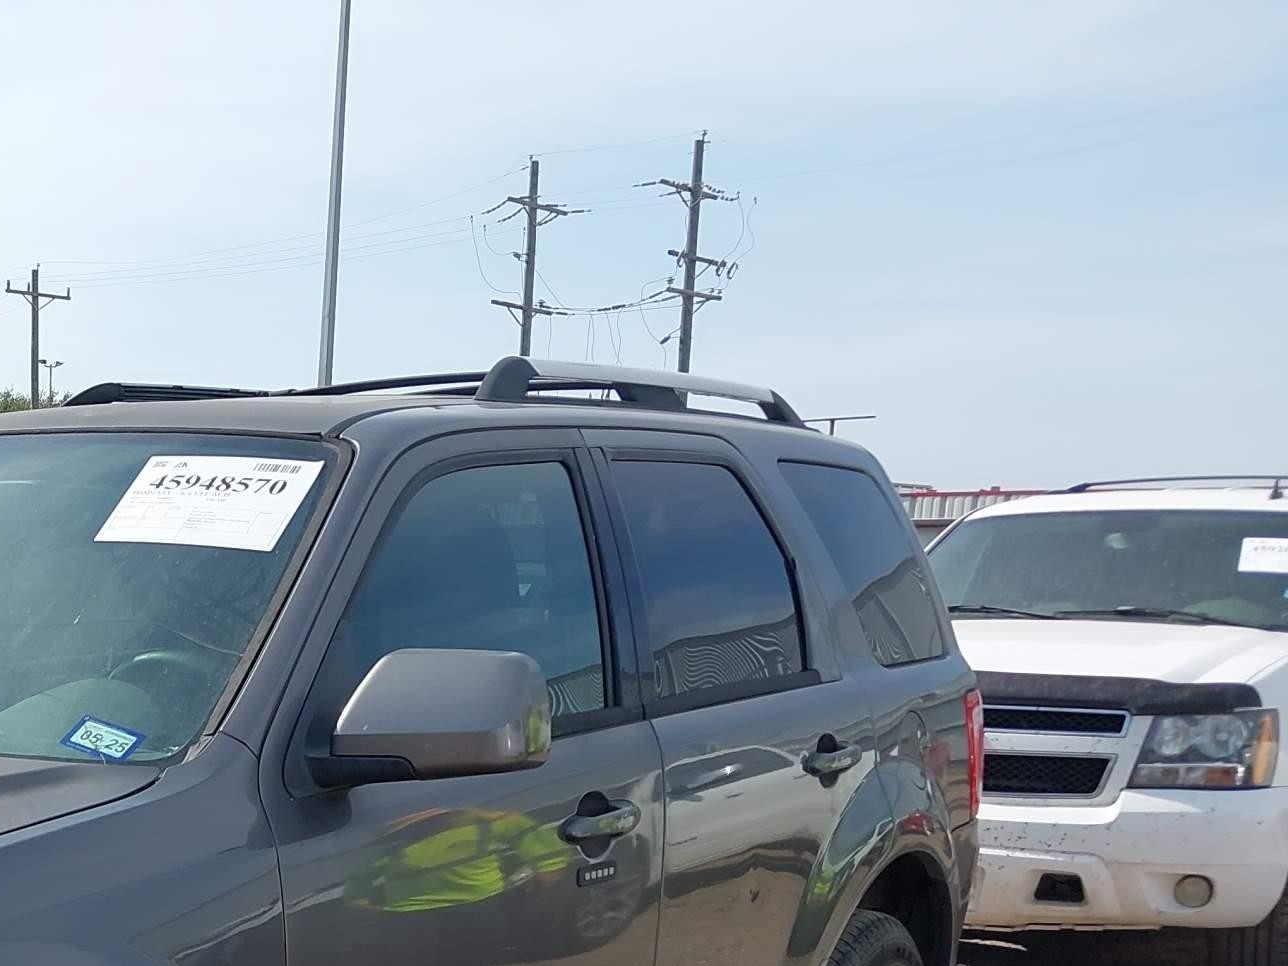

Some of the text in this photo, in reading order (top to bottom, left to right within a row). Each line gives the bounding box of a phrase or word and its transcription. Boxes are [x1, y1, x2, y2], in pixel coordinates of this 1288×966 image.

[149, 474, 288, 496] 45948570
[79, 729, 104, 745] 05
[104, 738, 129, 753] 25
